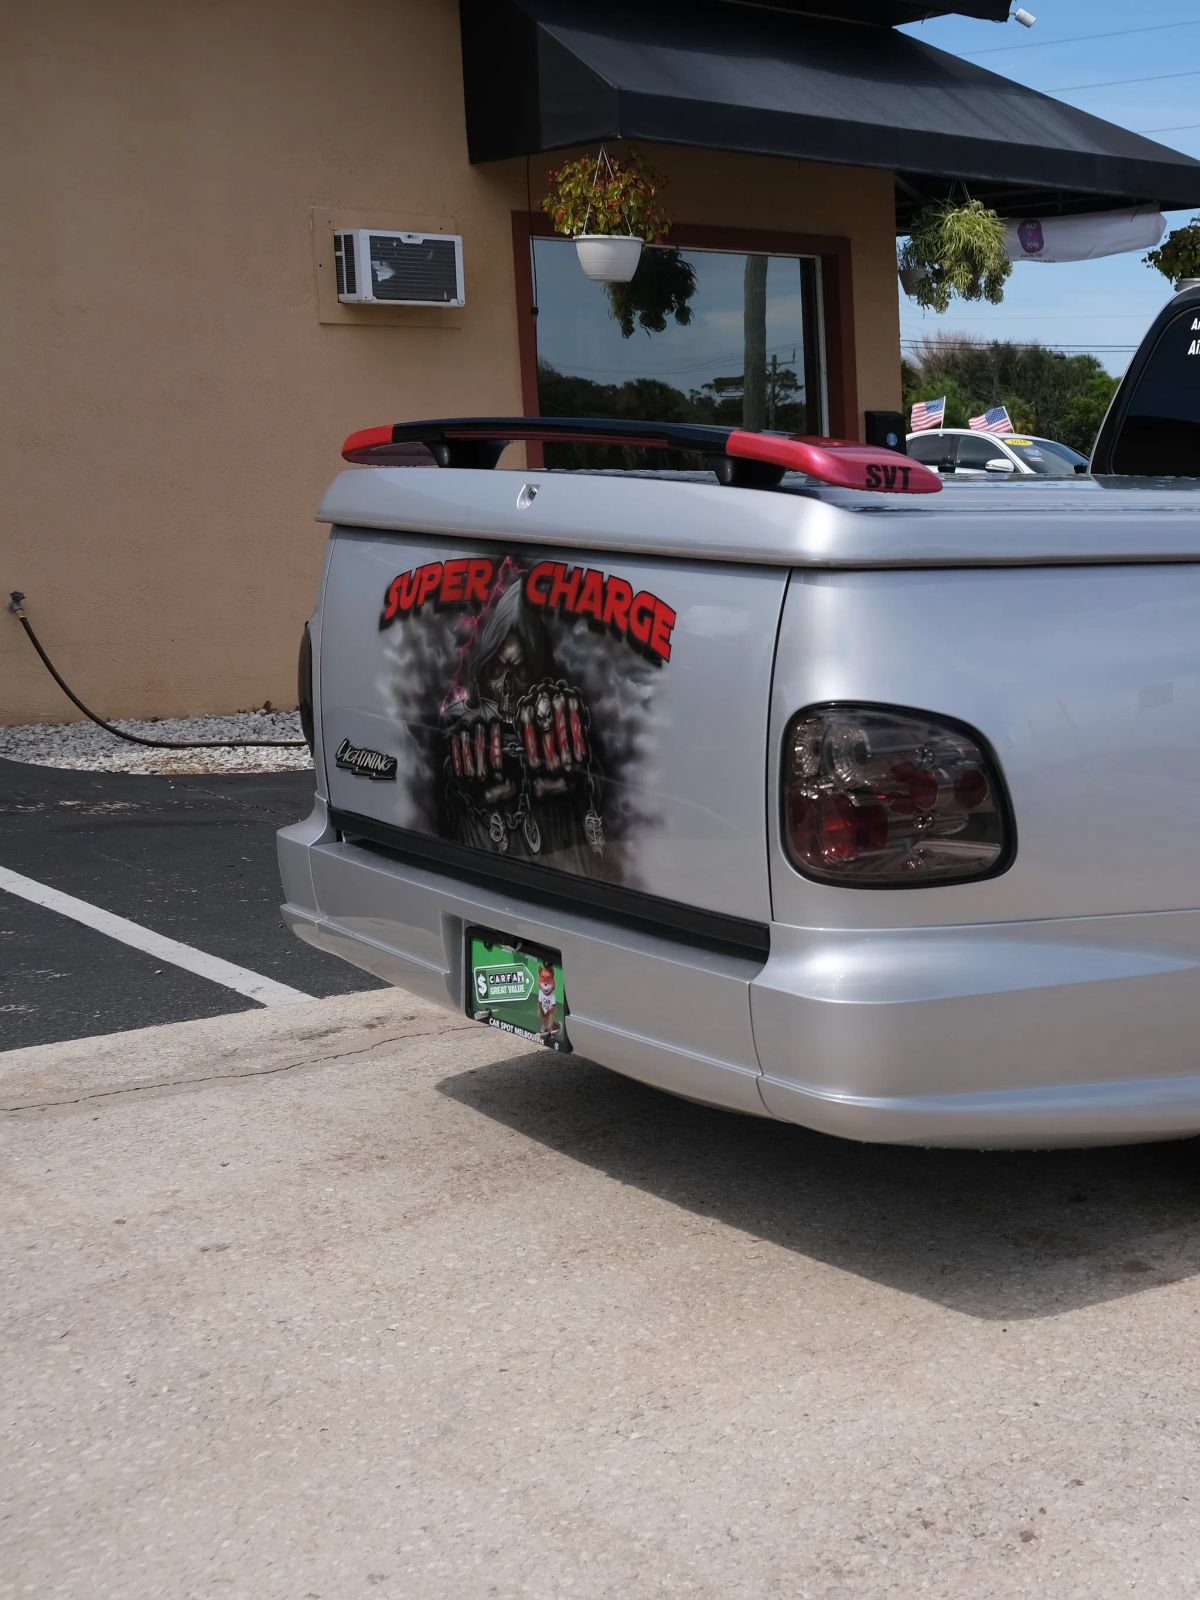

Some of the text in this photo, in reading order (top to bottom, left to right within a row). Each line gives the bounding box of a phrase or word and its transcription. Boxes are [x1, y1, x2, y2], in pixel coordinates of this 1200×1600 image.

[865, 463, 912, 490] SVT
[382, 557, 677, 665] SUPER CHARGE
[335, 739, 395, 772] LIGHTNING
[490, 984, 526, 995] GREAT VALUE
[489, 1017, 500, 1028] CAR
[500, 1021, 514, 1033] SPOT
